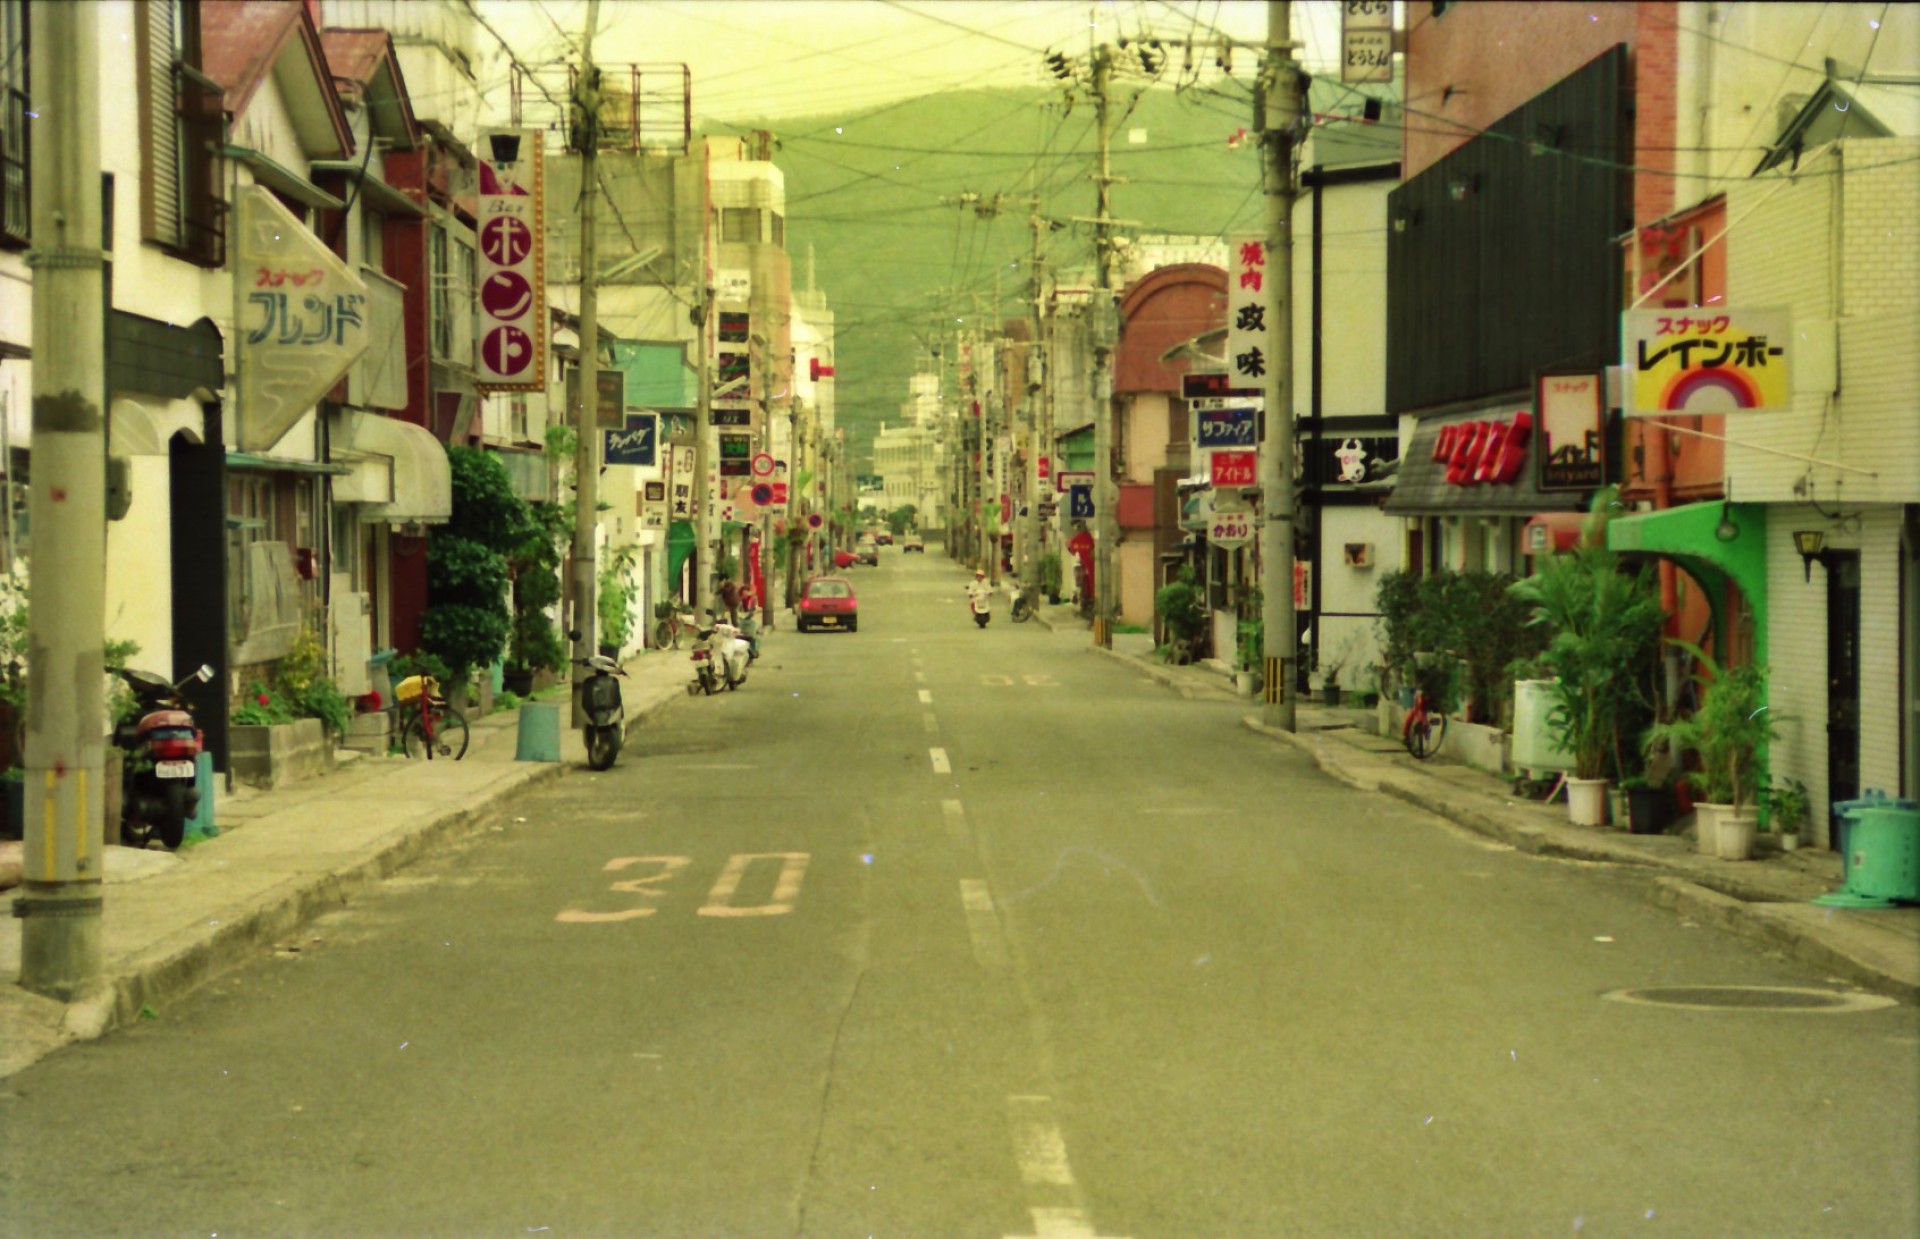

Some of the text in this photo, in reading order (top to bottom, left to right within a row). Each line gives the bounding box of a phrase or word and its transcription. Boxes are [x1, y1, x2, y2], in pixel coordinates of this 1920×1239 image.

[256, 267, 324, 287] スナック
[1240, 241, 1265, 292] 焼肉
[482, 216, 533, 376] ボンド
[247, 291, 366, 345] フレンド
[1656, 315, 1730, 335] スナック
[1638, 336, 1784, 371] レインボー
[1214, 466, 1252, 480] アイドル
[1213, 523, 1248, 538] かおり
[553, 852, 811, 922] 30
